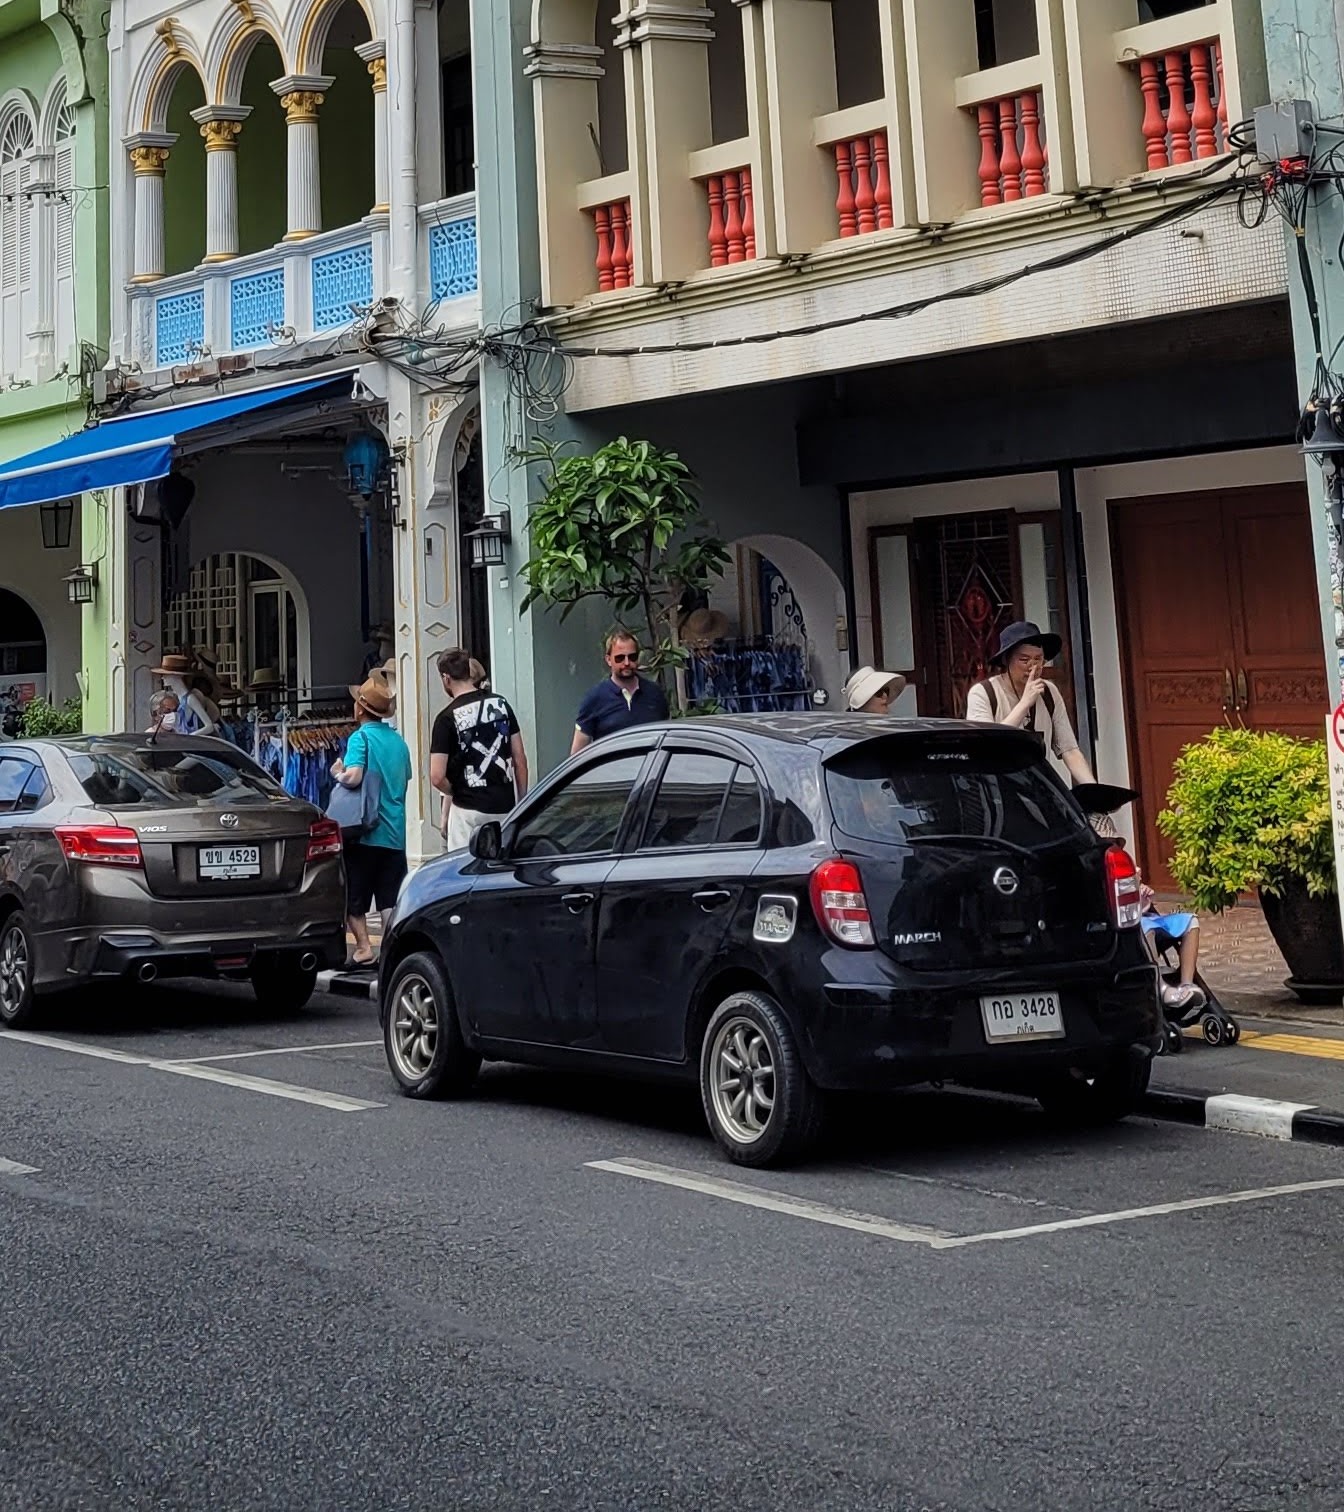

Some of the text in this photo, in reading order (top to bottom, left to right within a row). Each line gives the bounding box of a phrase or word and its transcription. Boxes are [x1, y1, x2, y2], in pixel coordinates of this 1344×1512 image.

[138, 825, 168, 833] VIOS
[228, 849, 257, 863] 4529
[894, 931, 942, 946] MARCH
[991, 996, 1056, 1020] กอ 3428
